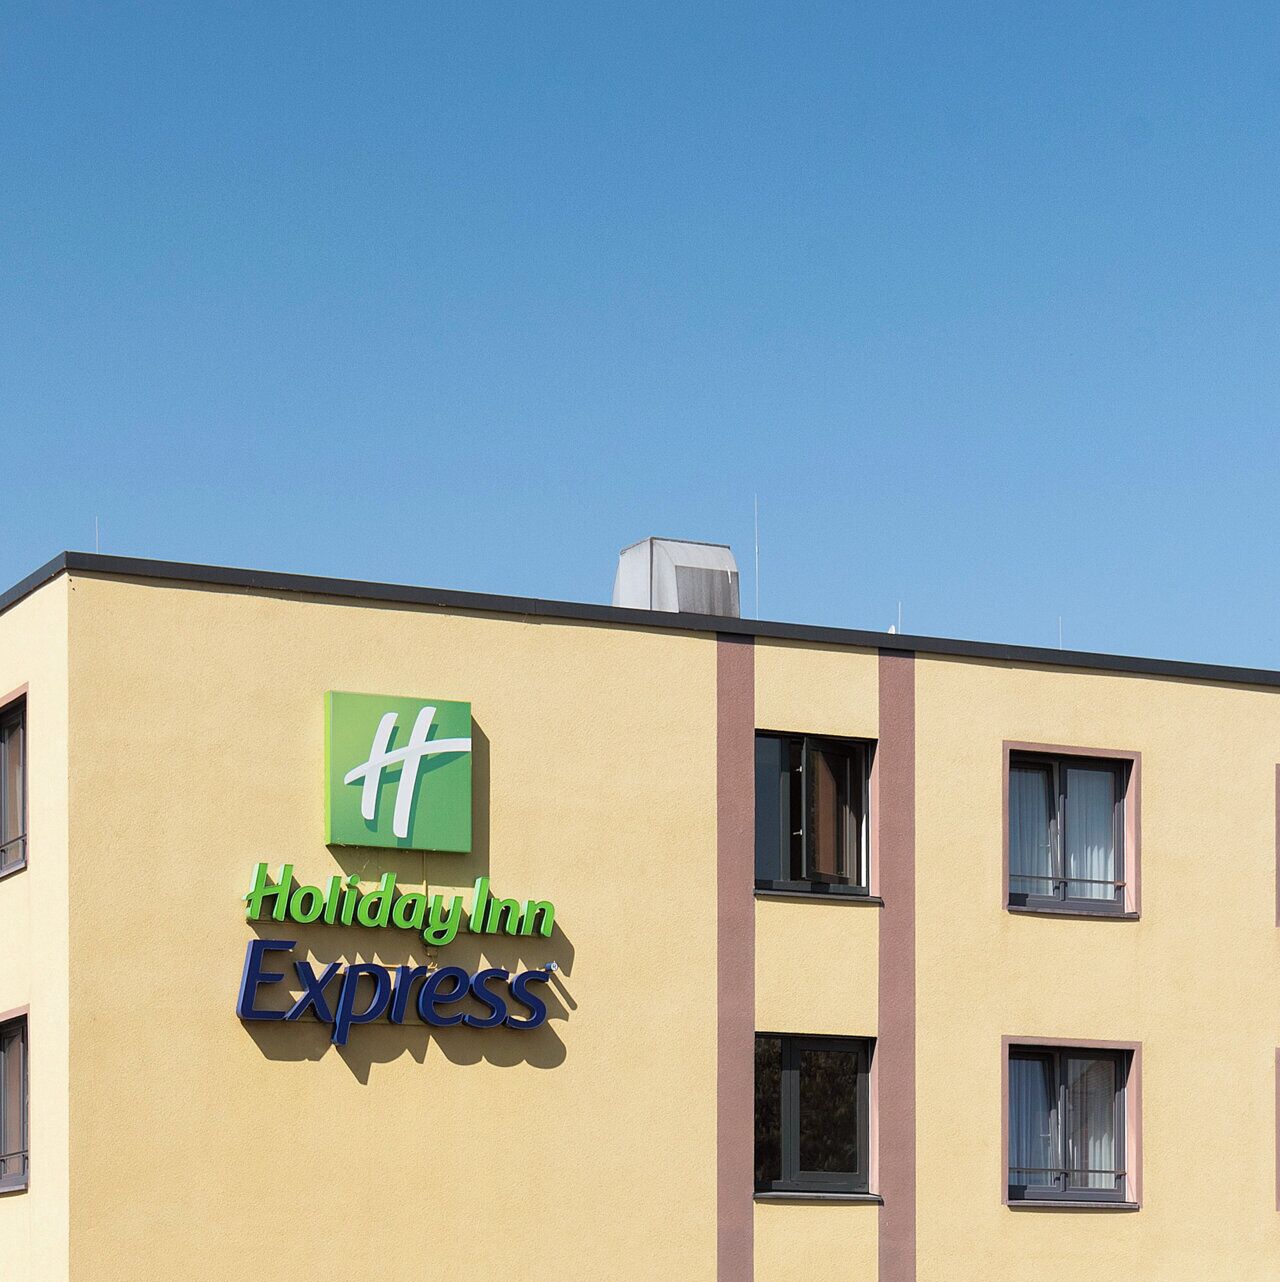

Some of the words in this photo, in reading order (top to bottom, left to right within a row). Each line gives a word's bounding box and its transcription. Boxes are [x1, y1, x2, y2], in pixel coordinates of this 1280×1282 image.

[242, 863, 463, 946] Holiday
[470, 876, 555, 938] Inn
[236, 939, 551, 1046] Express
